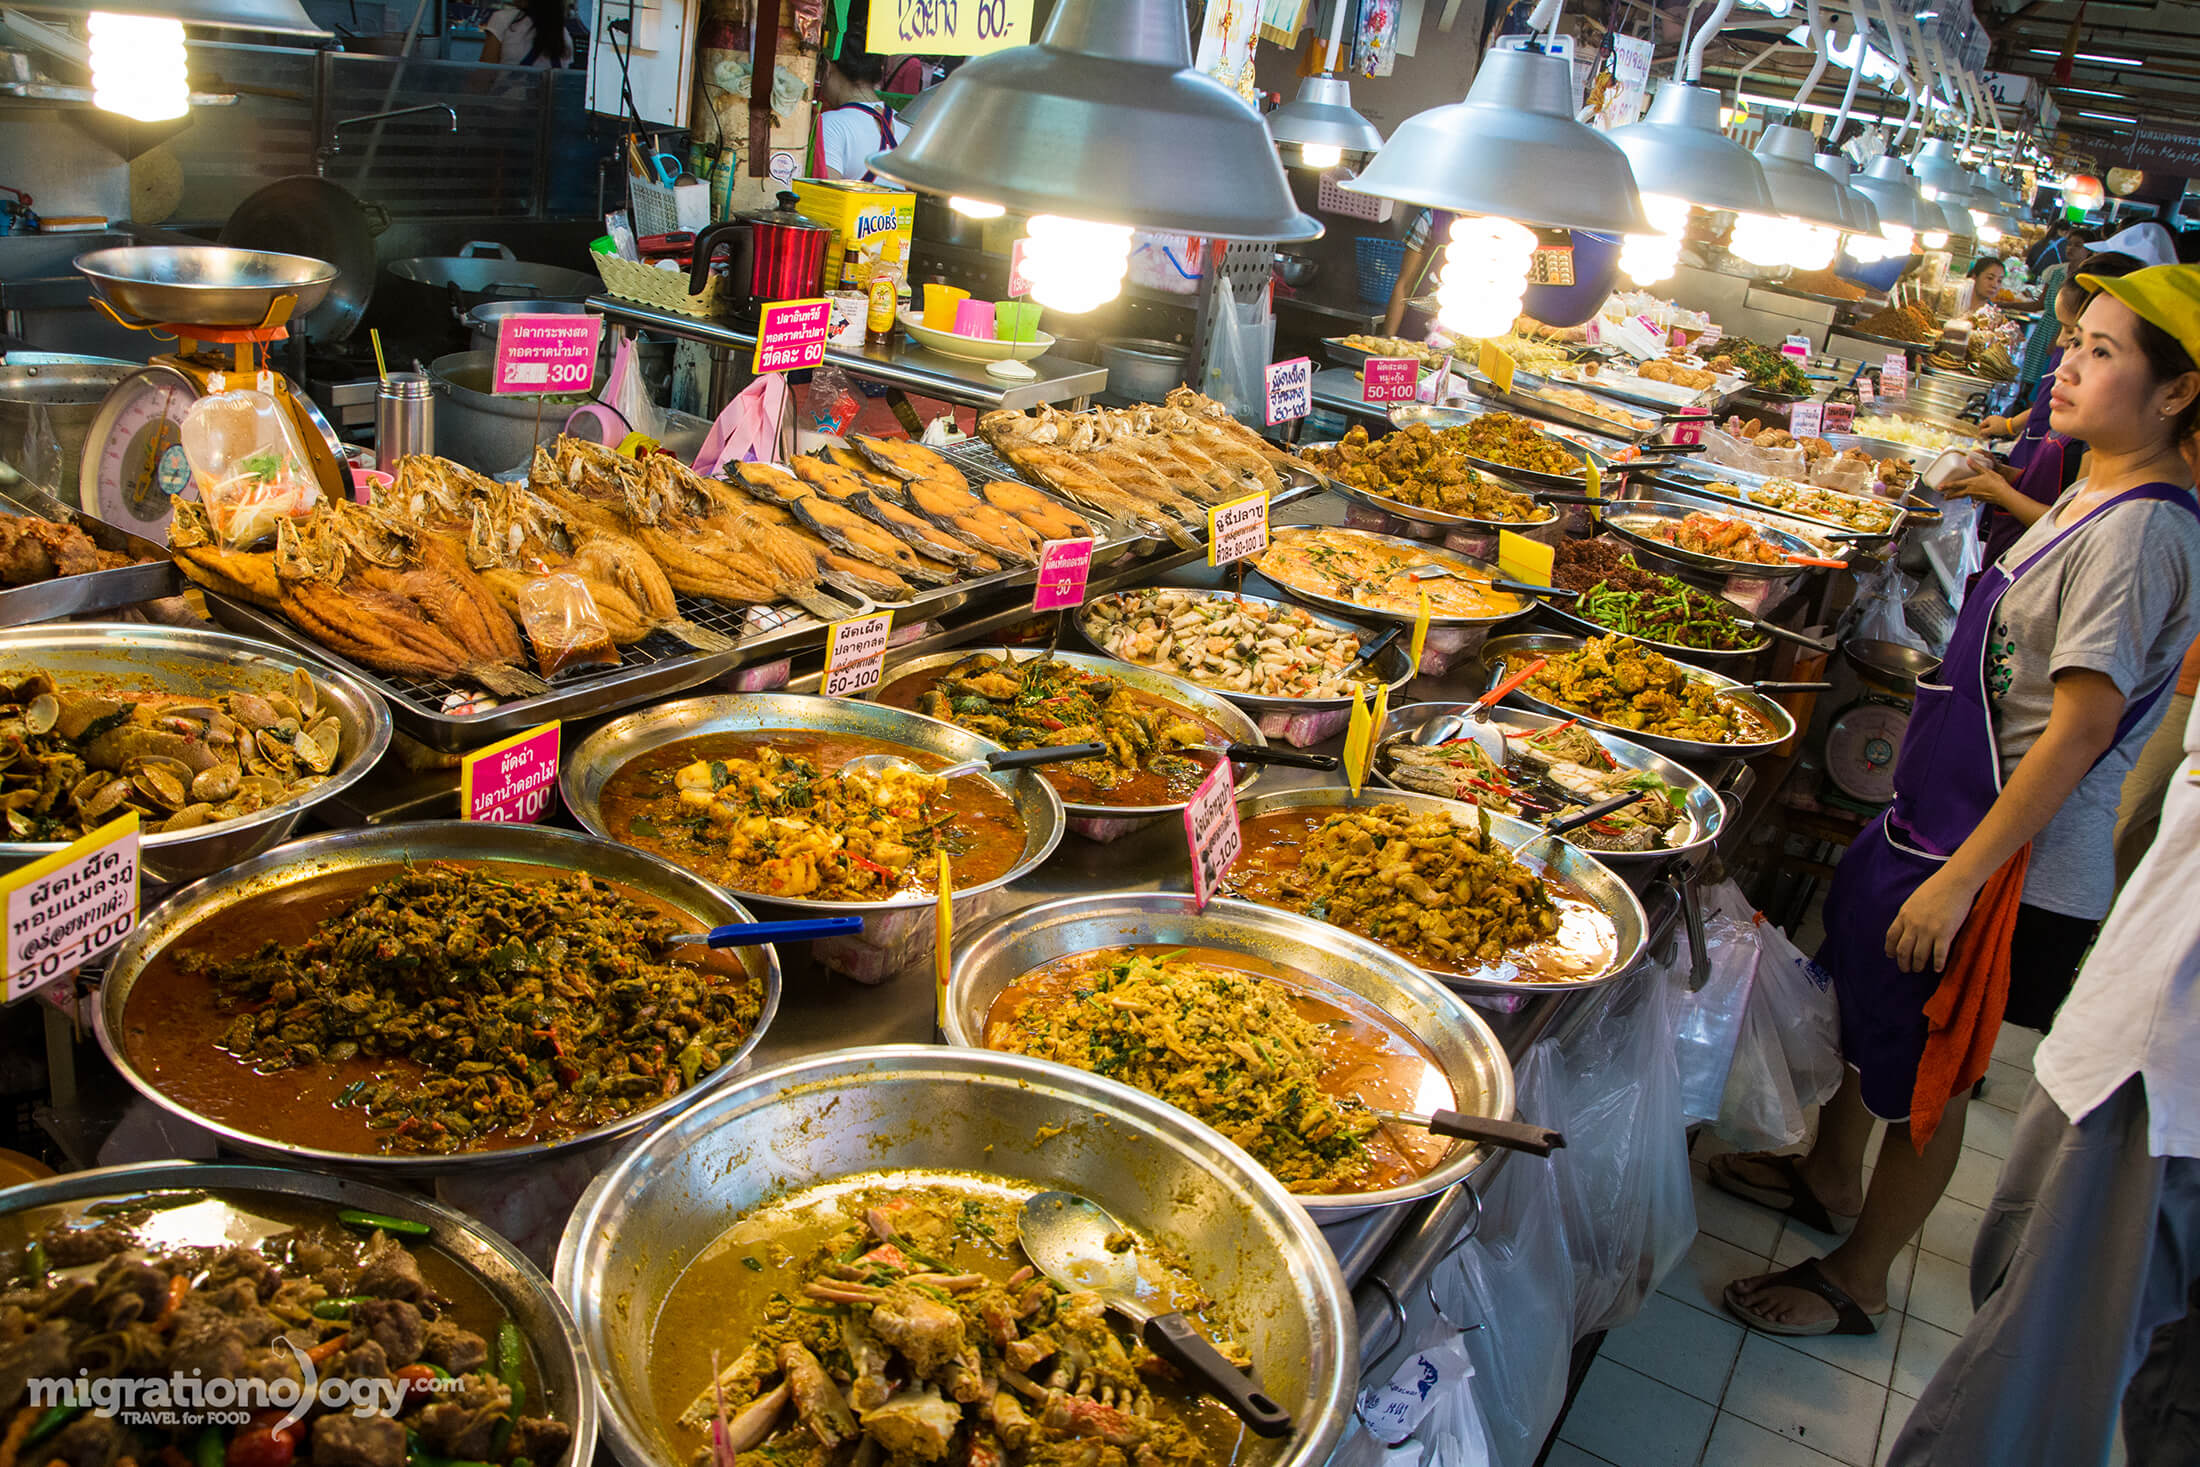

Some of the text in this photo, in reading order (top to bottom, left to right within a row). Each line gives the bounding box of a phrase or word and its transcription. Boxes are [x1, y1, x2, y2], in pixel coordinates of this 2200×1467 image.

[513, 326, 588, 339] ปลากระพงสด
[766, 323, 825, 344] ทอดราดน้ำปลา
[508, 340, 589, 357] ทอดราดน้ำปลา
[762, 344, 822, 367] ขีดละ 60
[1367, 385, 1413, 398] 50-100
[1056, 577, 1072, 596] 50
[840, 619, 884, 639] ผัดเผ็ด
[834, 636, 885, 656] ปลาดุกสด
[828, 669, 879, 695] 50-100
[501, 746, 534, 774] ผัดฉ่า
[474, 759, 555, 812] ปลาน้ำดอกไม้
[30, 851, 120, 907] ผัดเผ็ด
[13, 860, 133, 936] หอยแมลงภู่
[18, 913, 131, 989] 50-100
